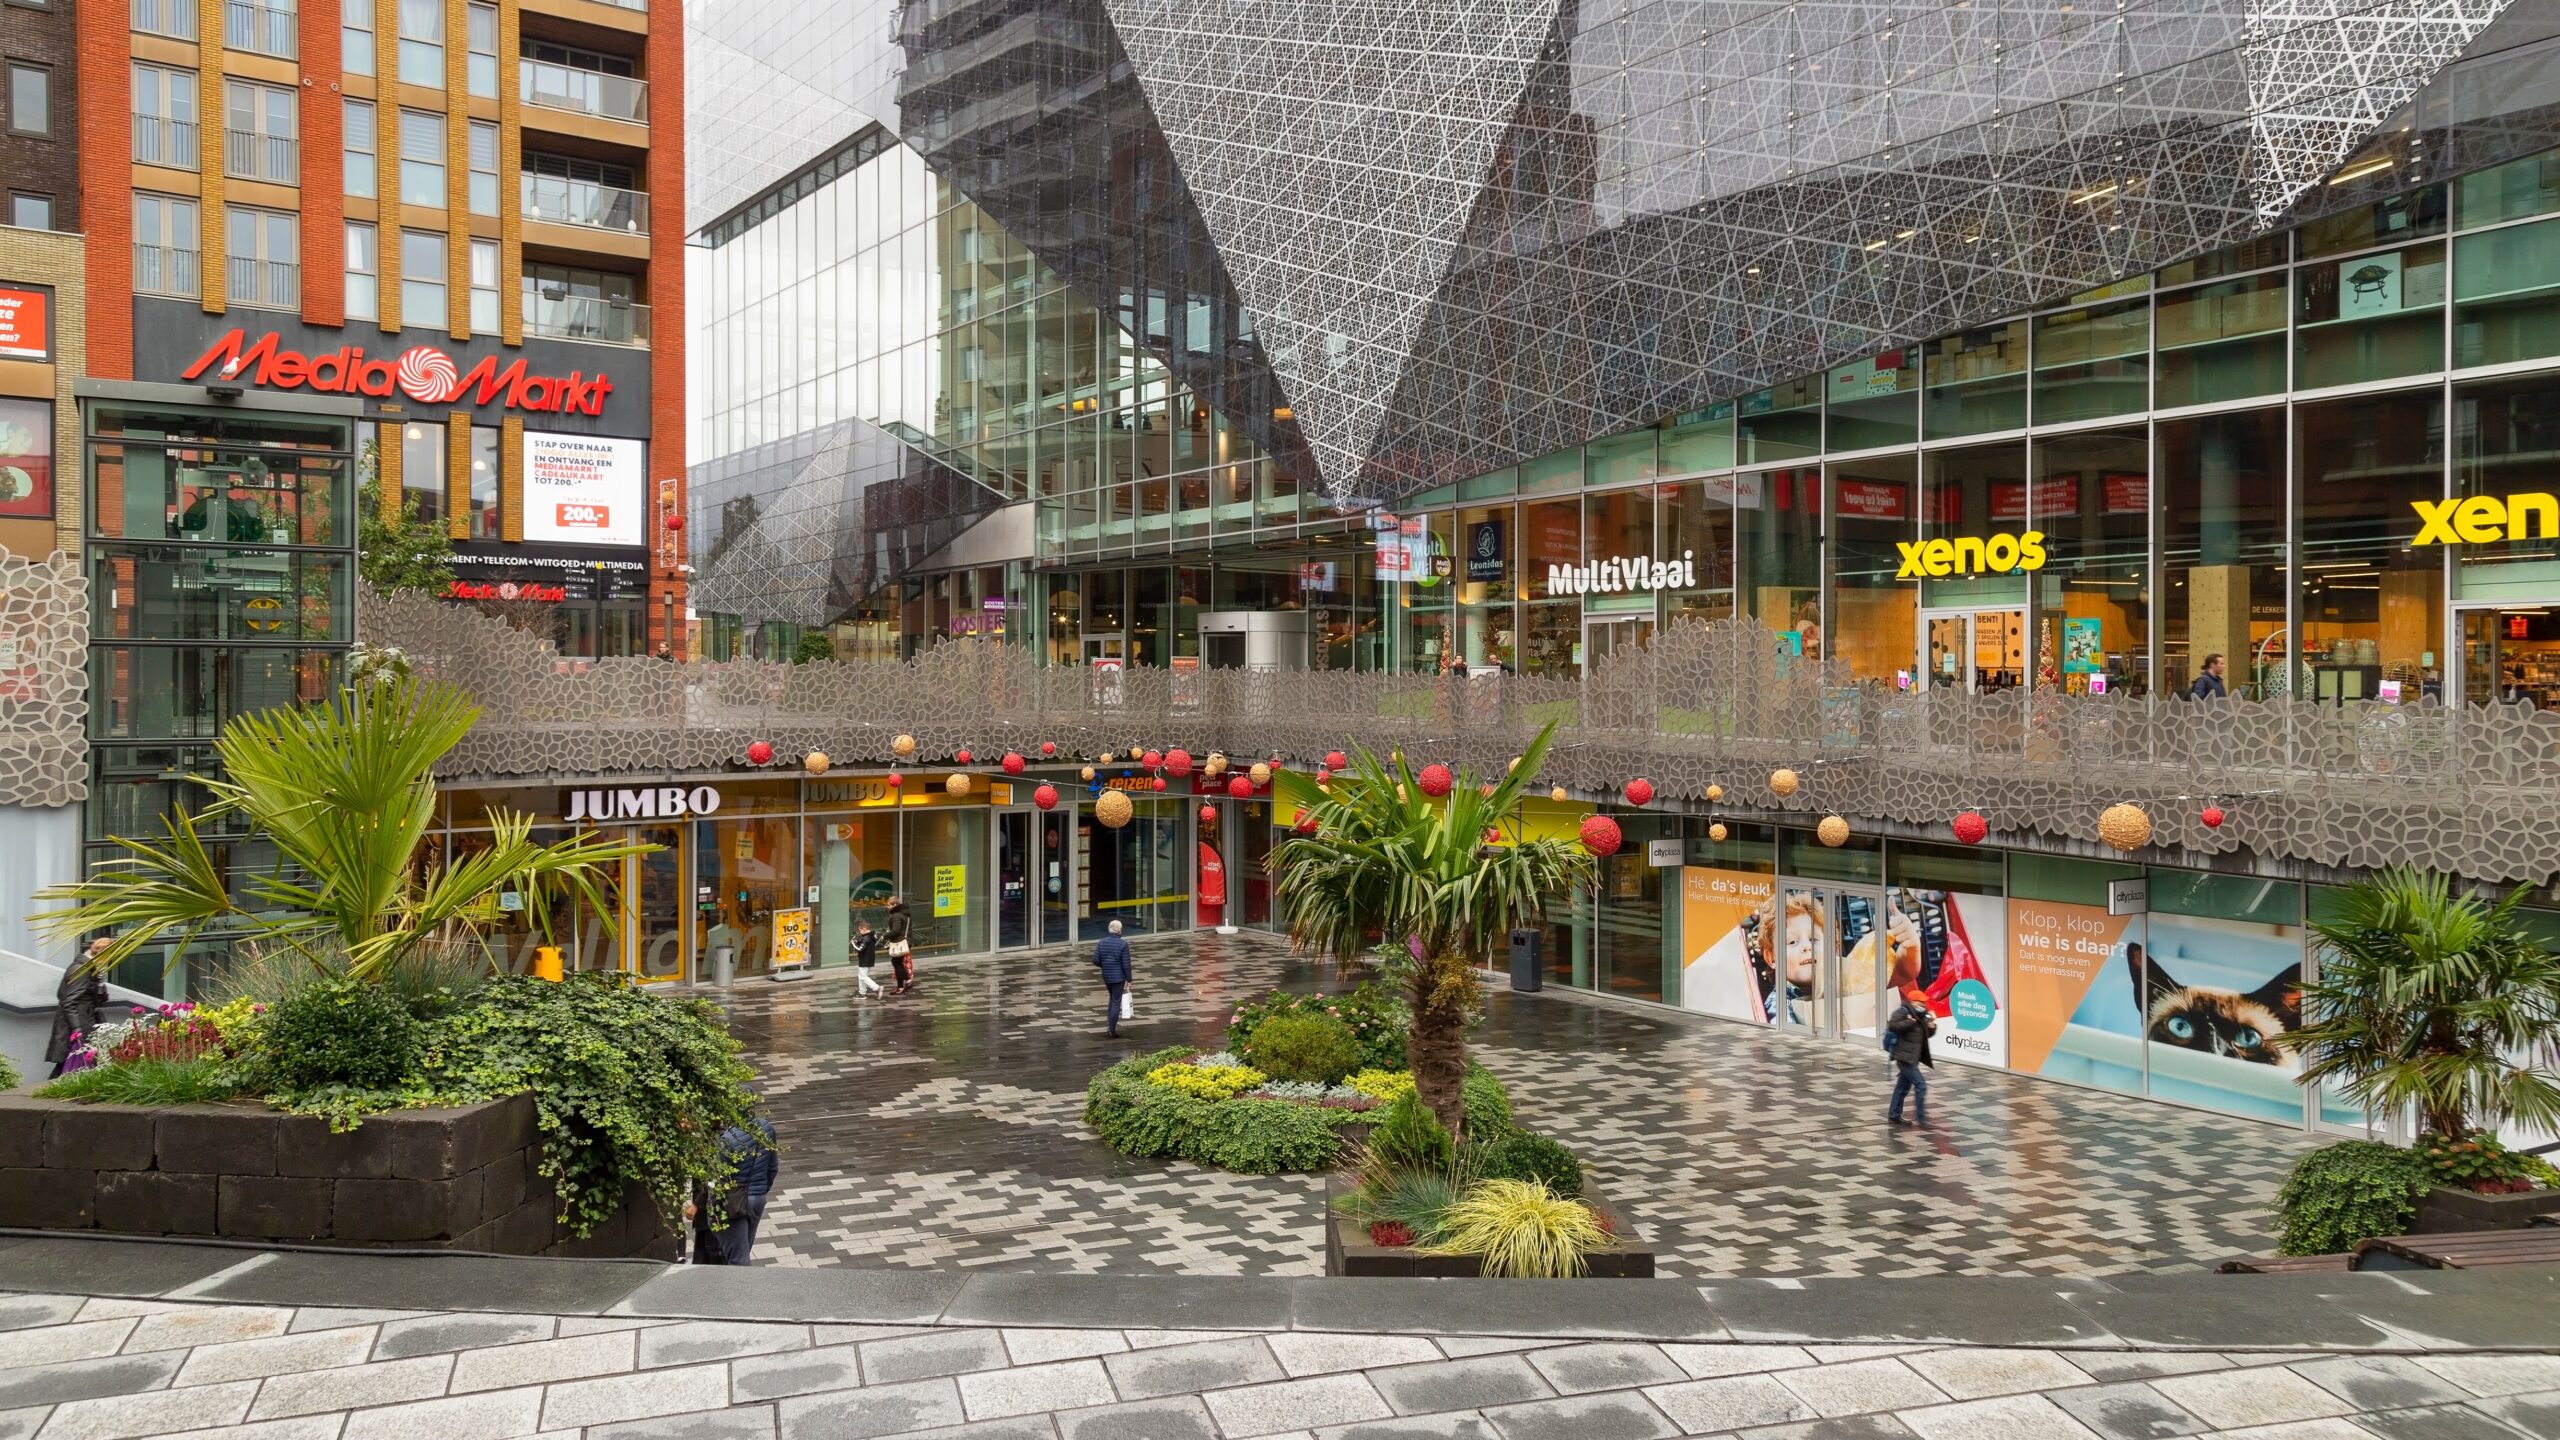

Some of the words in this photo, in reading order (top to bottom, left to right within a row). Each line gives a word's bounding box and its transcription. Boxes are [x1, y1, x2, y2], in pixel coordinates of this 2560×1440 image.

[534, 440, 557, 448] STAP
[559, 442, 584, 451] OVER
[586, 444, 613, 453] NAAR
[548, 456, 594, 466] ONTVANG
[534, 463, 599, 473] MEDIAMARKT
[534, 470, 604, 481] CADEAUKAART
[534, 477, 552, 485] TOT
[563, 505, 604, 522] 200.-
[1896, 531, 2047, 579] xenos
[1470, 559, 1504, 570] Leonidas
[1548, 549, 1696, 596] MultiVlaai
[951, 614, 1004, 633] KOSTER
[1976, 615, 1998, 623] BENT!
[1201, 779, 1222, 789] place
[804, 782, 886, 803] JUMBO
[564, 786, 720, 821] JUMBO
[1653, 848, 1681, 858] cityplaza
[936, 881, 953, 890] gratis
[936, 886, 964, 896] parkeren!
[1688, 875, 1708, 891] Hé,
[1711, 878, 1737, 892] da's
[1740, 881, 1770, 897] leuk!
[1688, 891, 1703, 900] Hier
[1705, 893, 1725, 903] komt
[1726, 896, 1740, 905] iets
[2116, 890, 2145, 904] cityplaza
[782, 924, 799, 933] 100
[2019, 909, 2061, 932] Klop,
[2067, 914, 2105, 938] klop
[2019, 931, 2050, 949] wie
[2055, 933, 2070, 951] is
[2075, 937, 2128, 958] daar?
[2019, 949, 2035, 959] Dat
[2037, 952, 2045, 961] is
[2047, 955, 2065, 966] nog
[2067, 957, 2091, 967] even
[2019, 963, 2036, 972] een
[2039, 965, 2086, 981] verrassing
[1957, 991, 1977, 1000] Maak
[1957, 1000, 1972, 1008] elke
[1973, 1002, 1987, 1012] dag
[1957, 1008, 1989, 1019] bijzonder
[1945, 1034, 1991, 1052] cityplaza
